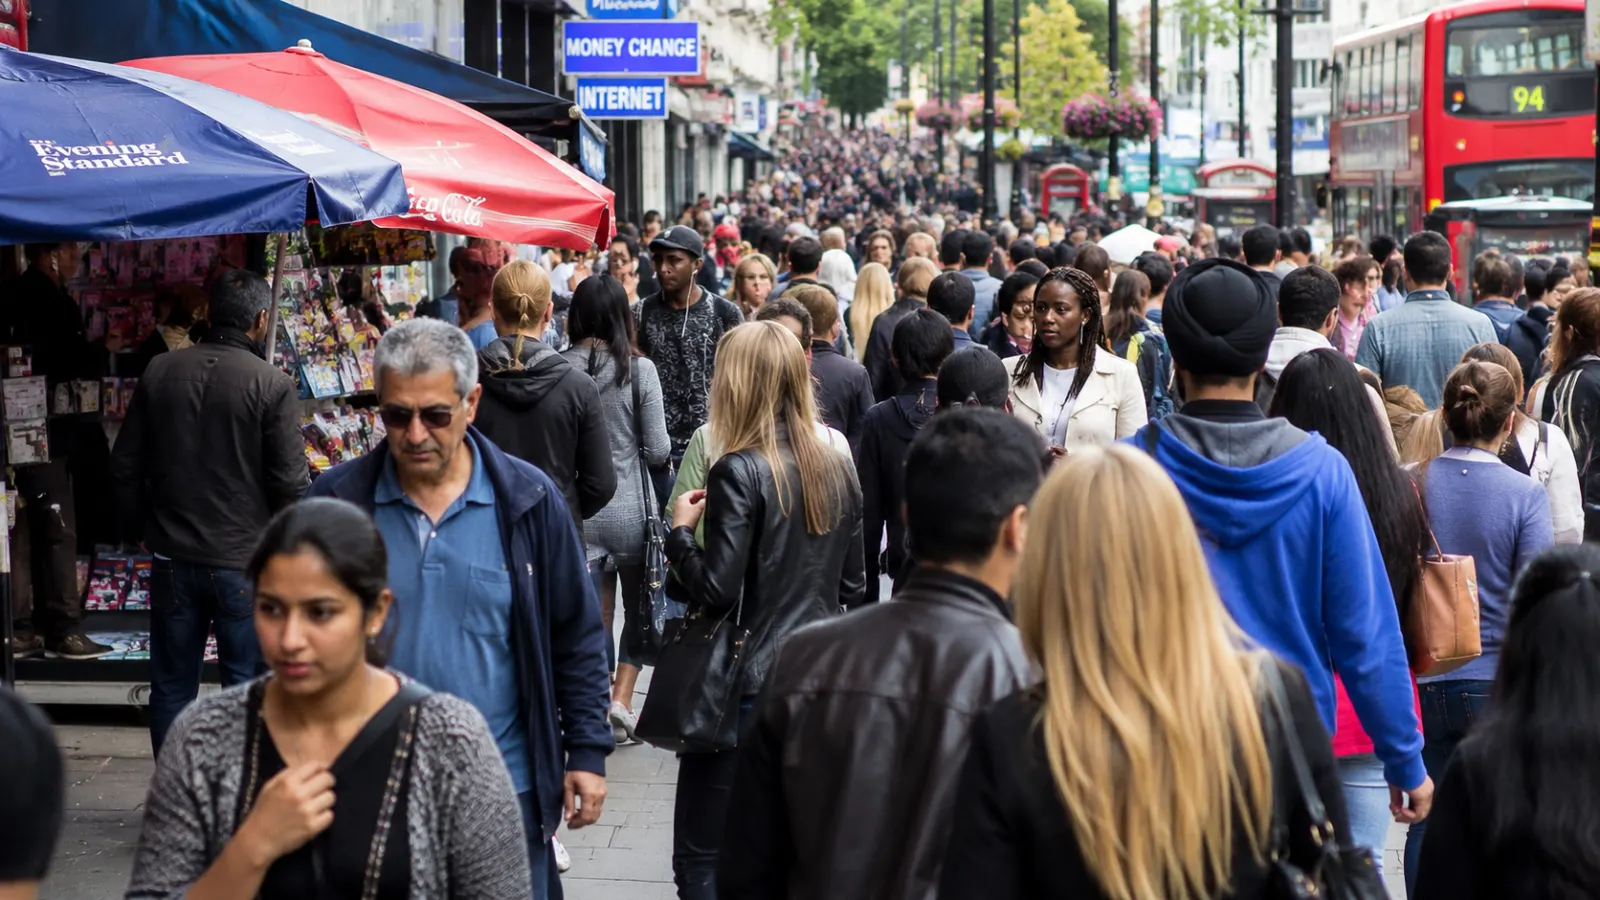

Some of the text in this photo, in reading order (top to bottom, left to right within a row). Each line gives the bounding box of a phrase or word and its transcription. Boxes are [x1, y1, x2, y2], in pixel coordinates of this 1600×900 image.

[566, 37, 697, 57] MONEY CHANGE
[579, 86, 664, 110] INTERNET
[1513, 85, 1545, 112] 94
[32, 141, 162, 157] Evening
[41, 151, 189, 171] Standard
